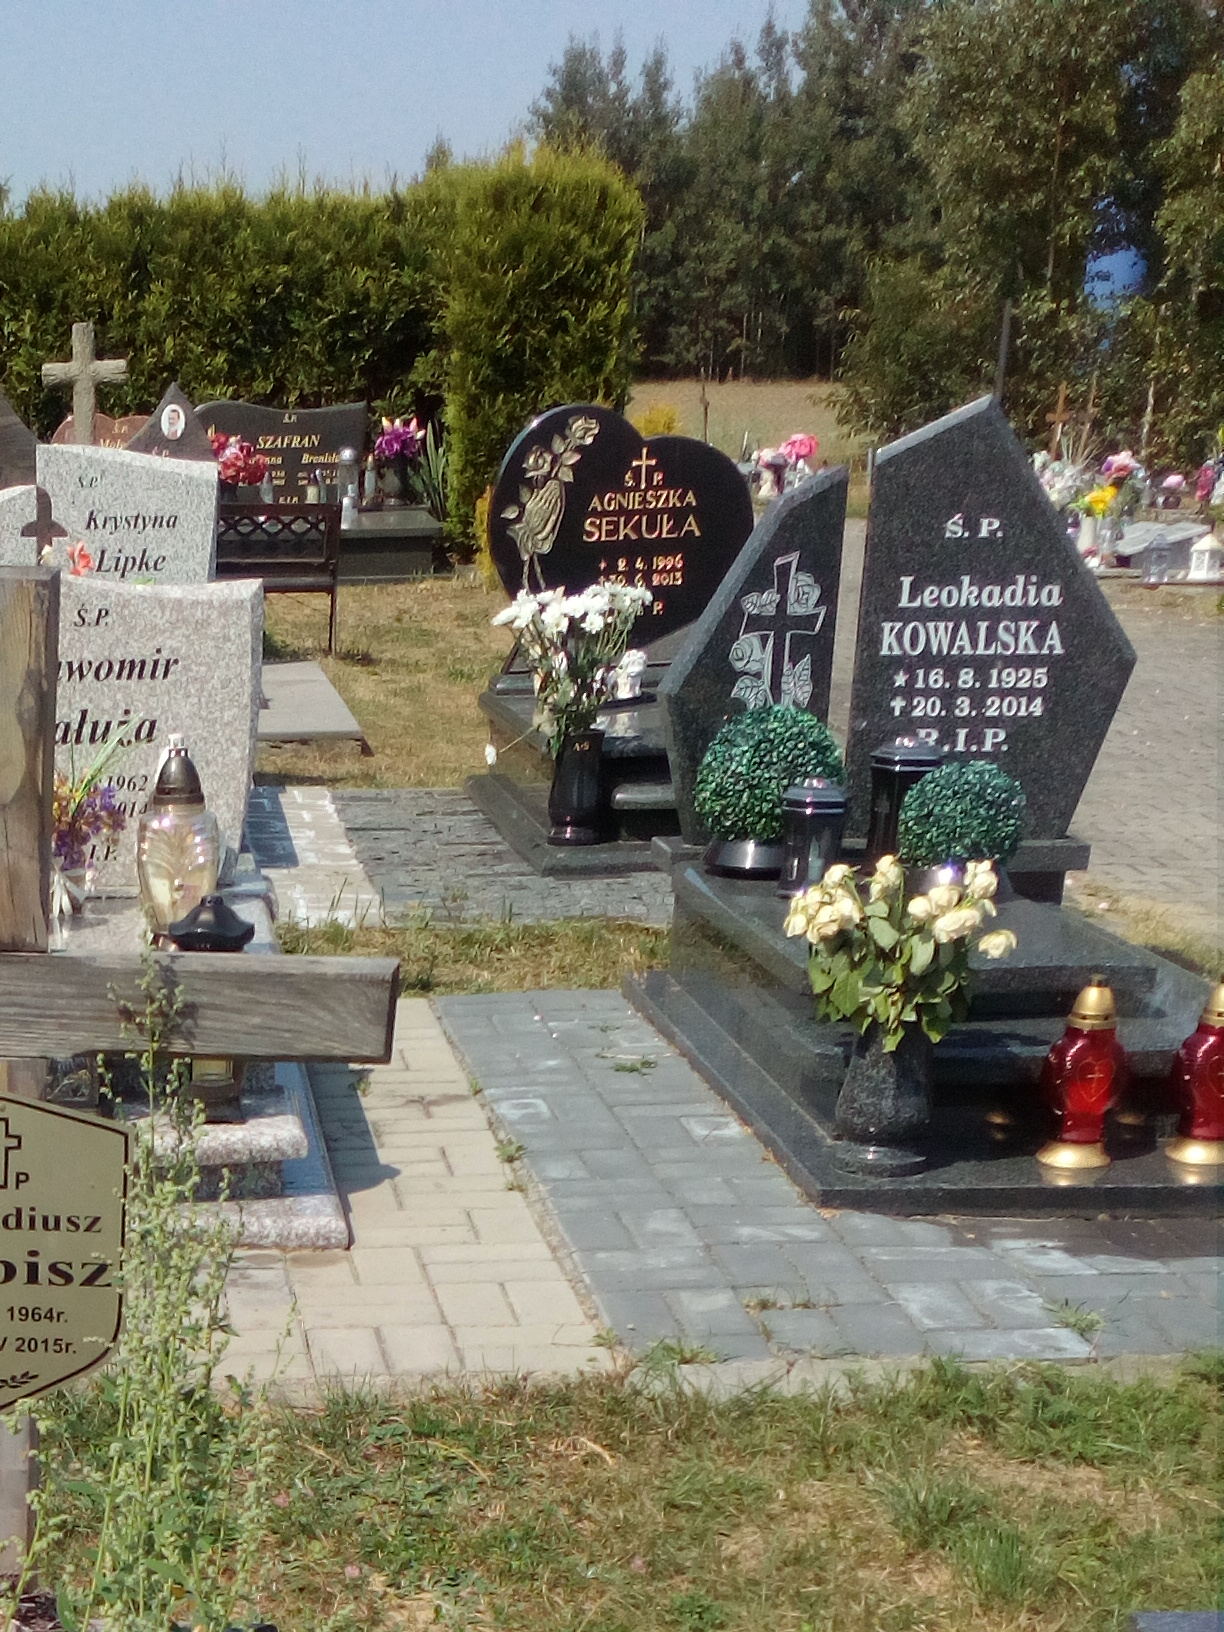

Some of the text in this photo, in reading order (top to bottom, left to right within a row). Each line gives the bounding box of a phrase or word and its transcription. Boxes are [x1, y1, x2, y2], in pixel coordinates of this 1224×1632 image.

[256, 434, 321, 449] SZAFRAN
[587, 488, 697, 512] AGNIESZKA
[85, 509, 178, 535] Krystyna
[582, 513, 702, 543] SEKUŁA
[978, 517, 1004, 539] P.
[95, 548, 167, 579] Lipke
[652, 552, 684, 571] 1996
[898, 574, 1064, 608] Leokadia
[879, 620, 1065, 656] KOWALSKA
[914, 666, 1049, 689] 16. 8. 1925
[911, 696, 1045, 717] 20. 3. 2014
[16, 1171, 30, 1190] P
[7, 1306, 69, 1324] 1964r.
[15, 1337, 77, 1354] 2015r.
